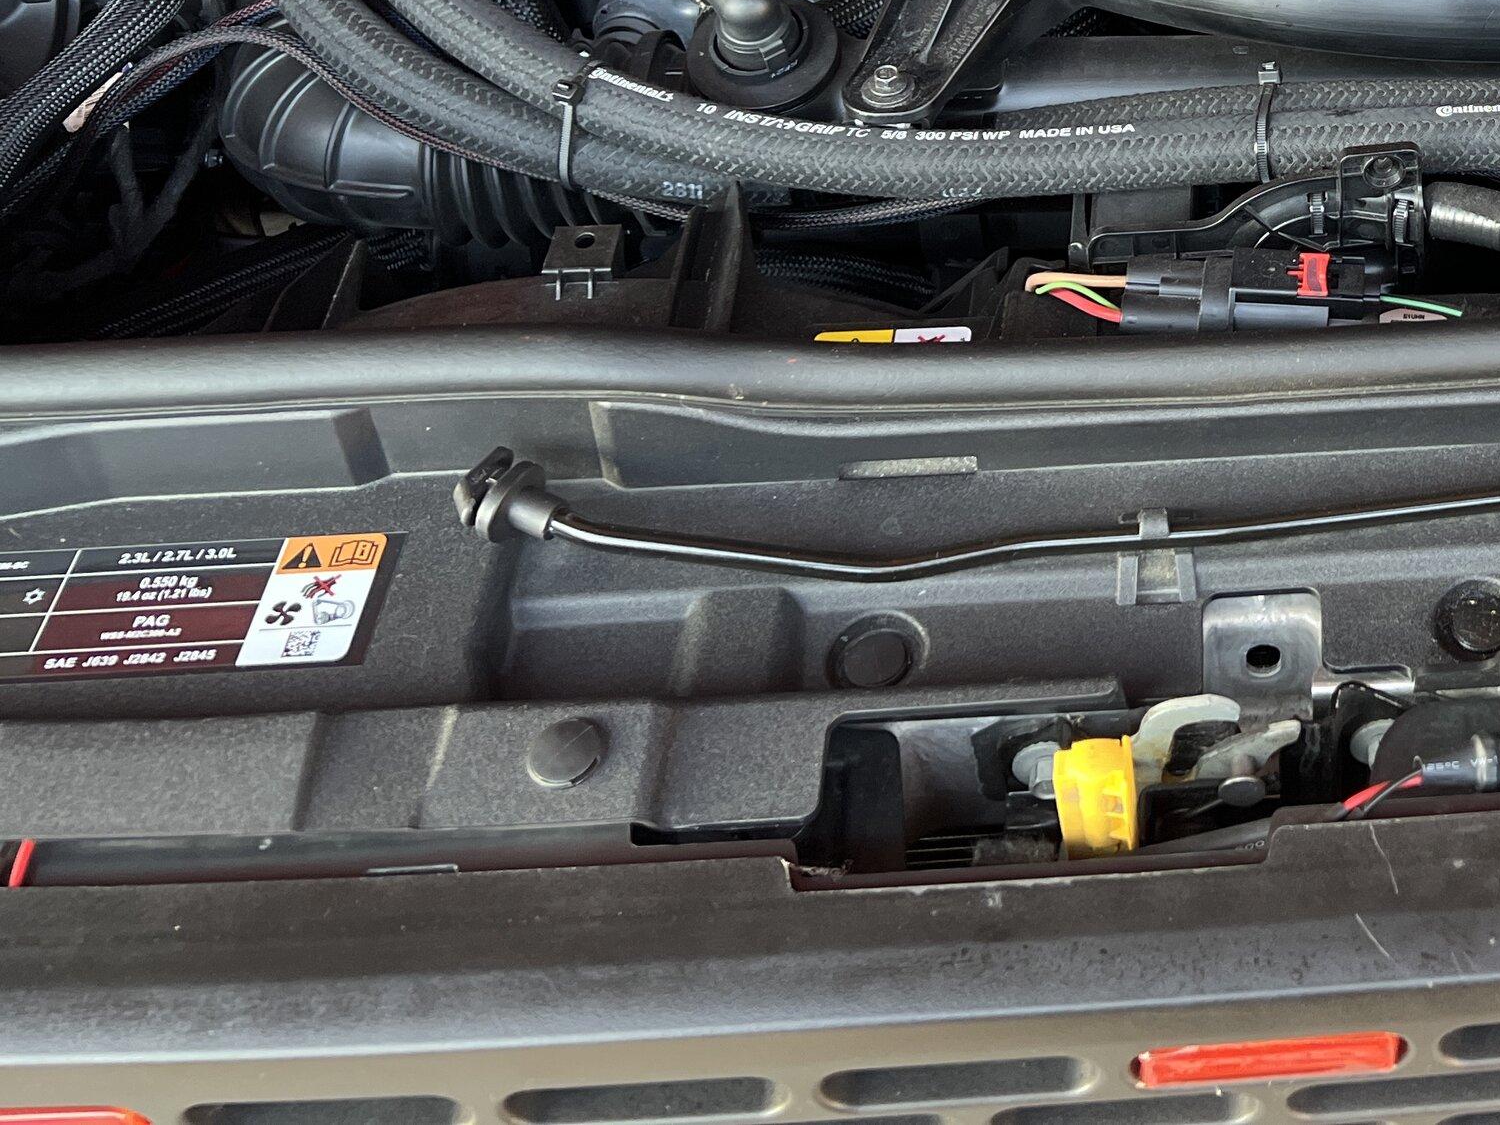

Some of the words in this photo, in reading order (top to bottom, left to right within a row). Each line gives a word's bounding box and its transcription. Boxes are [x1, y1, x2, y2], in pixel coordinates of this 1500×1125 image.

[696, 103, 718, 115] 10
[846, 128, 871, 138] TC
[880, 130, 907, 140] 5/8
[915, 131, 946, 141] 300
[949, 131, 978, 141] PSI
[982, 130, 1011, 140] WP
[1018, 128, 1071, 139] MADE
[1076, 125, 1094, 135] IN
[1098, 124, 1136, 135] USA
[118, 552, 151, 565] 2.3L
[162, 549, 195, 562] 2.7L
[205, 547, 237, 560] 3.0L
[139, 575, 178, 589] 0.550
[178, 575, 199, 589] kg
[132, 614, 171, 628] PAG
[44, 656, 78, 669] SAE
[82, 655, 119, 668] J639
[123, 652, 167, 666] J2842
